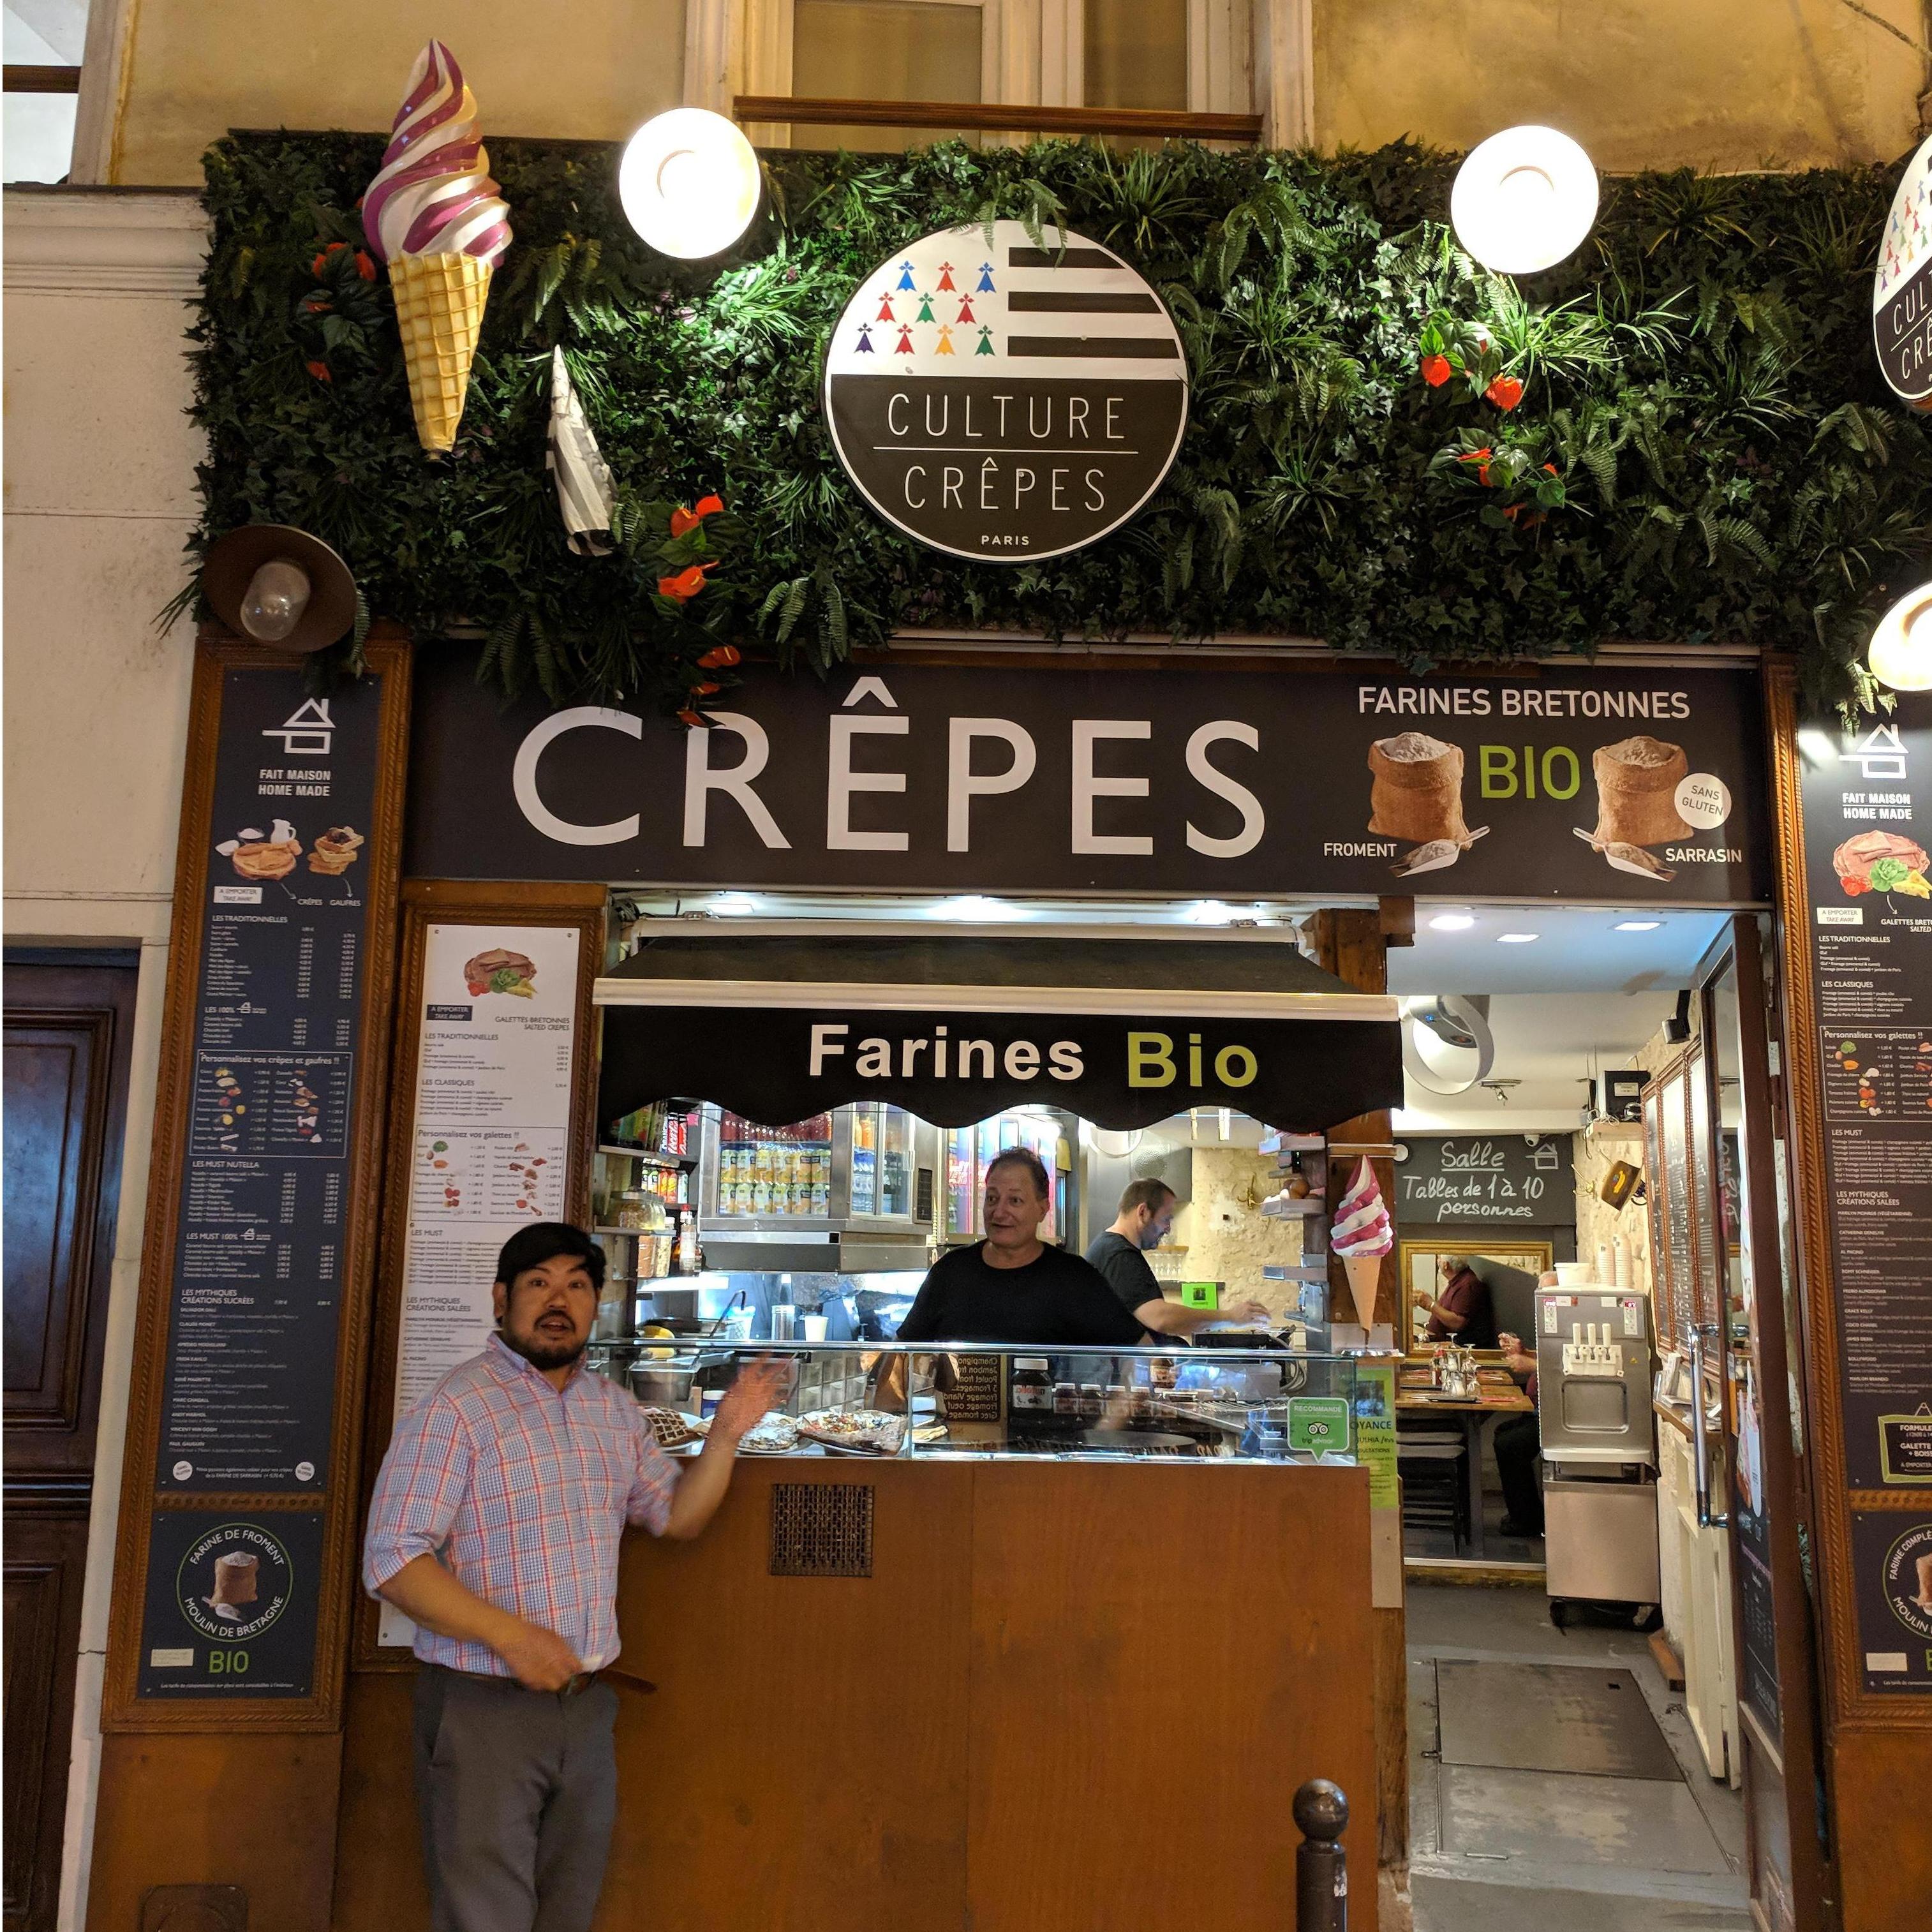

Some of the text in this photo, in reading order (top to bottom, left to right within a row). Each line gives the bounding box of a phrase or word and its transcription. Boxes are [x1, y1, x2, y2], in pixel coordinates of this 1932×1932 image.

[887, 393, 1125, 439] CULTURE
[904, 457, 1105, 512] CRÊPES
[981, 535, 1030, 546] PARIS
[1358, 687, 1690, 718] FARINES BRETONNES
[259, 769, 331, 781] FAIT MAISON
[512, 676, 1266, 859] CRÊPES
[1479, 745, 1581, 800] BIO
[258, 784, 331, 797] HOME MADE
[1691, 784, 1720, 800] SANS
[1843, 793, 1911, 805] FAIT MAISON
[1681, 797, 1723, 816] GLUTEN
[1843, 808, 1912, 820] HOME MADE
[1323, 842, 1397, 858] FROMENT
[1665, 847, 1743, 863] SARRASIN
[297, 898, 323, 907] CRÊPES
[1889, 1032, 1915, 1041] galettes
[200, 1055, 251, 1064] Personnalisez
[268, 1056, 294, 1065] crêpes
[305, 1056, 332, 1065] gaufres
[808, 1024, 1259, 1088] Farines Bio
[419, 1130, 468, 1138] Personnalisez
[484, 1131, 512, 1140] galettes
[1441, 1141, 1505, 1168] Salle
[1402, 1173, 1544, 1200] Tables de 1 à 10
[1436, 1202, 1534, 1222] personnes
[189, 1529, 285, 1566] FARINE DE FROMENT
[1889, 1548, 1905, 1580] FARINE
[184, 1596, 283, 1637] MOULIN DE BRETAGNE
[1893, 1596, 1928, 1632] MOULIN
[209, 1651, 249, 1674] BIO
